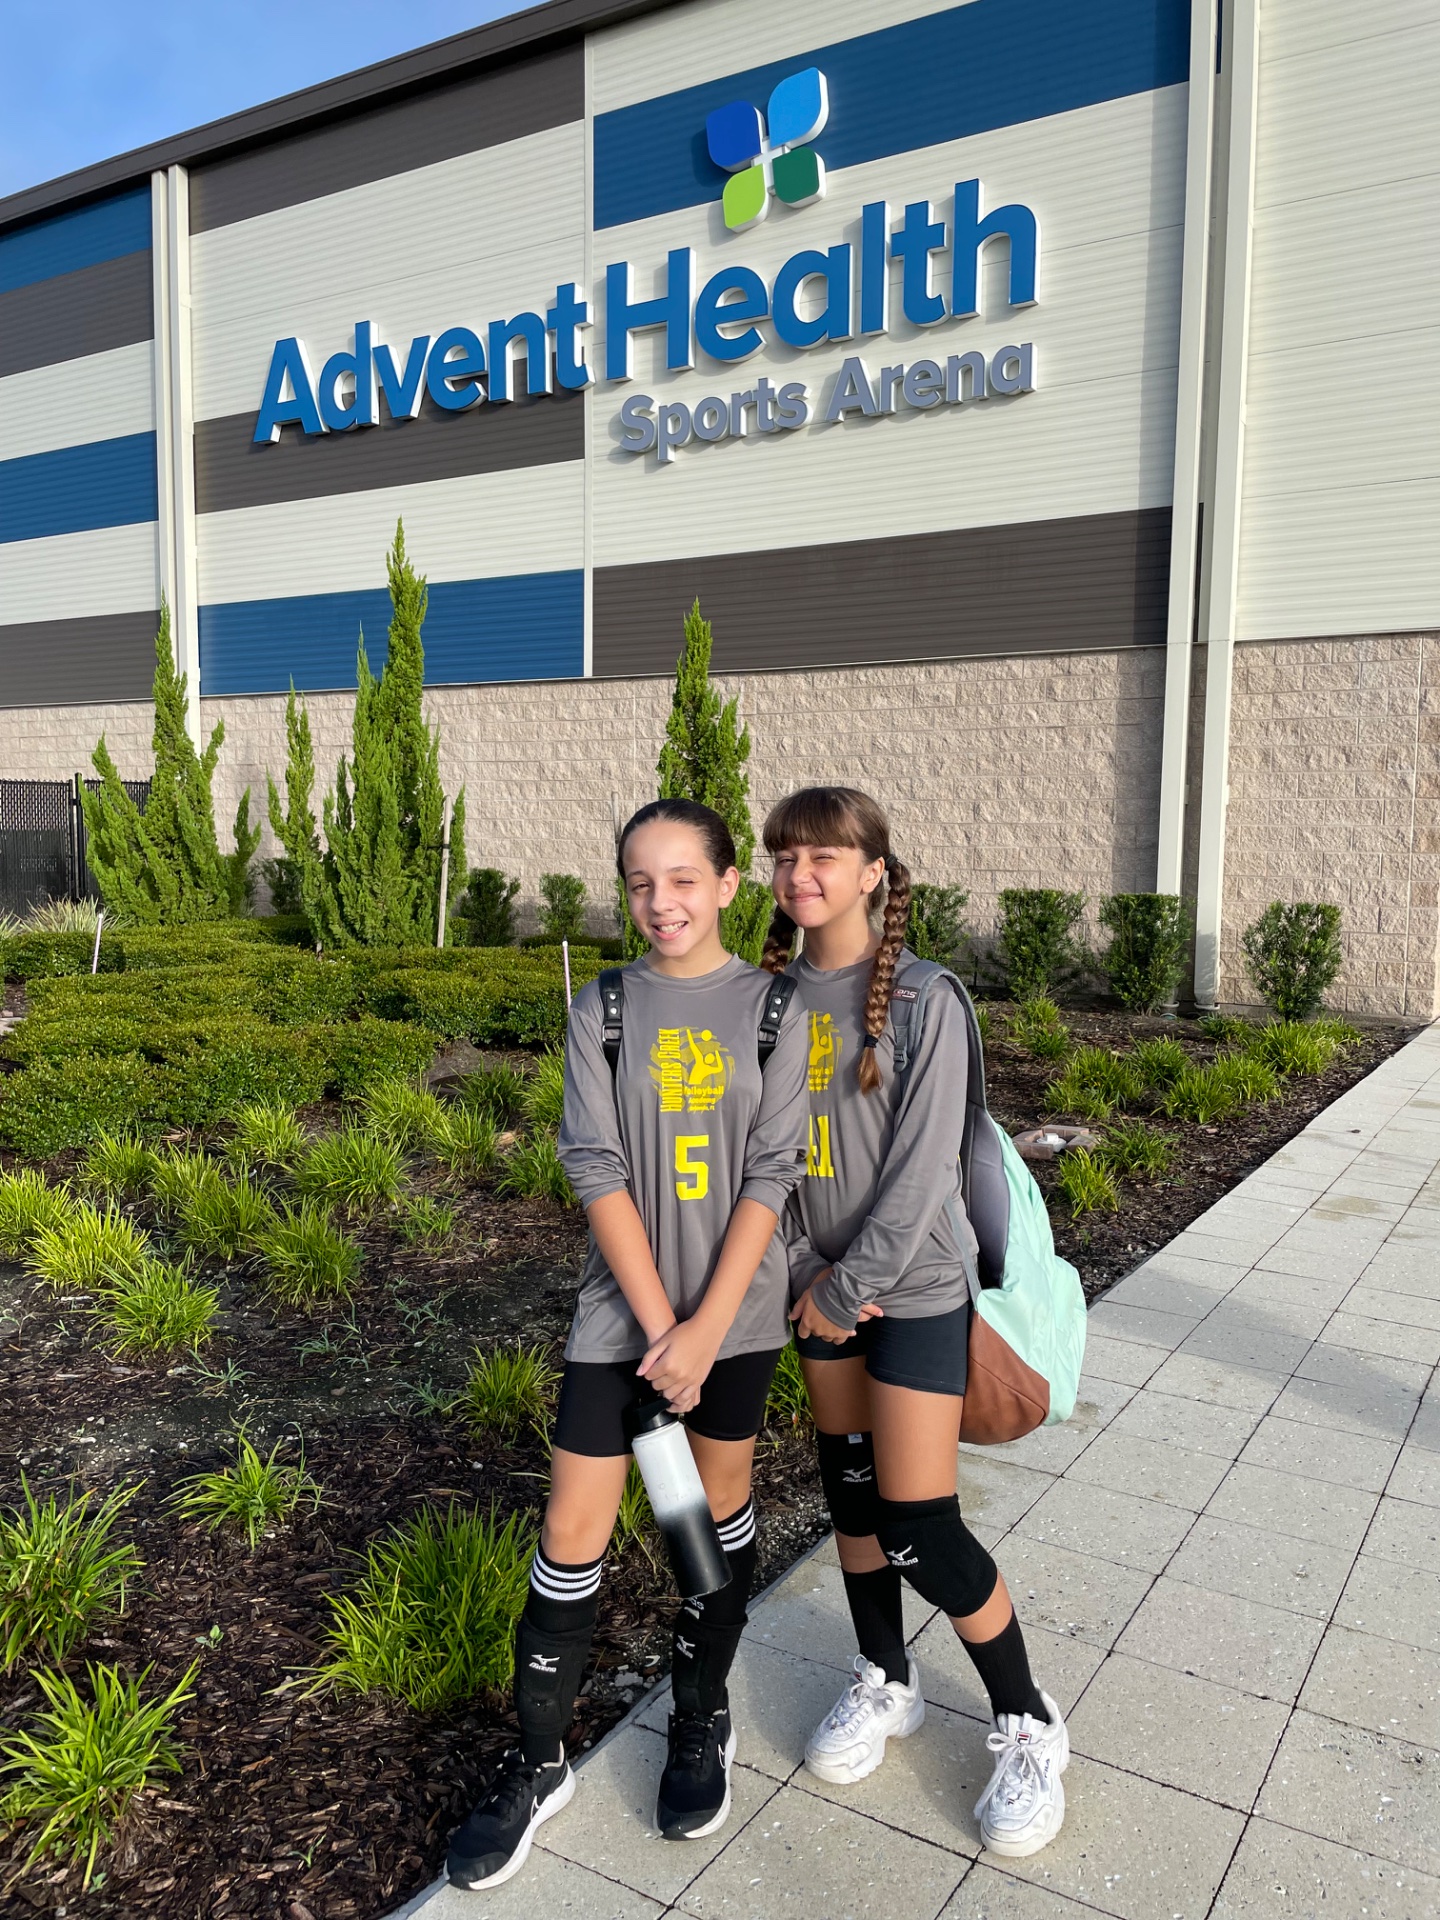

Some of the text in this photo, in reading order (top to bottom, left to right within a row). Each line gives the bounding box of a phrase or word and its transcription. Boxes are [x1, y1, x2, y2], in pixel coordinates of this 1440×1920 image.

[253, 178, 1042, 445] AdventHealth
[618, 342, 1039, 464] Sports Arena
[657, 1028, 683, 1113] HUNTERS CREEK
[675, 1135, 709, 1200] 5
